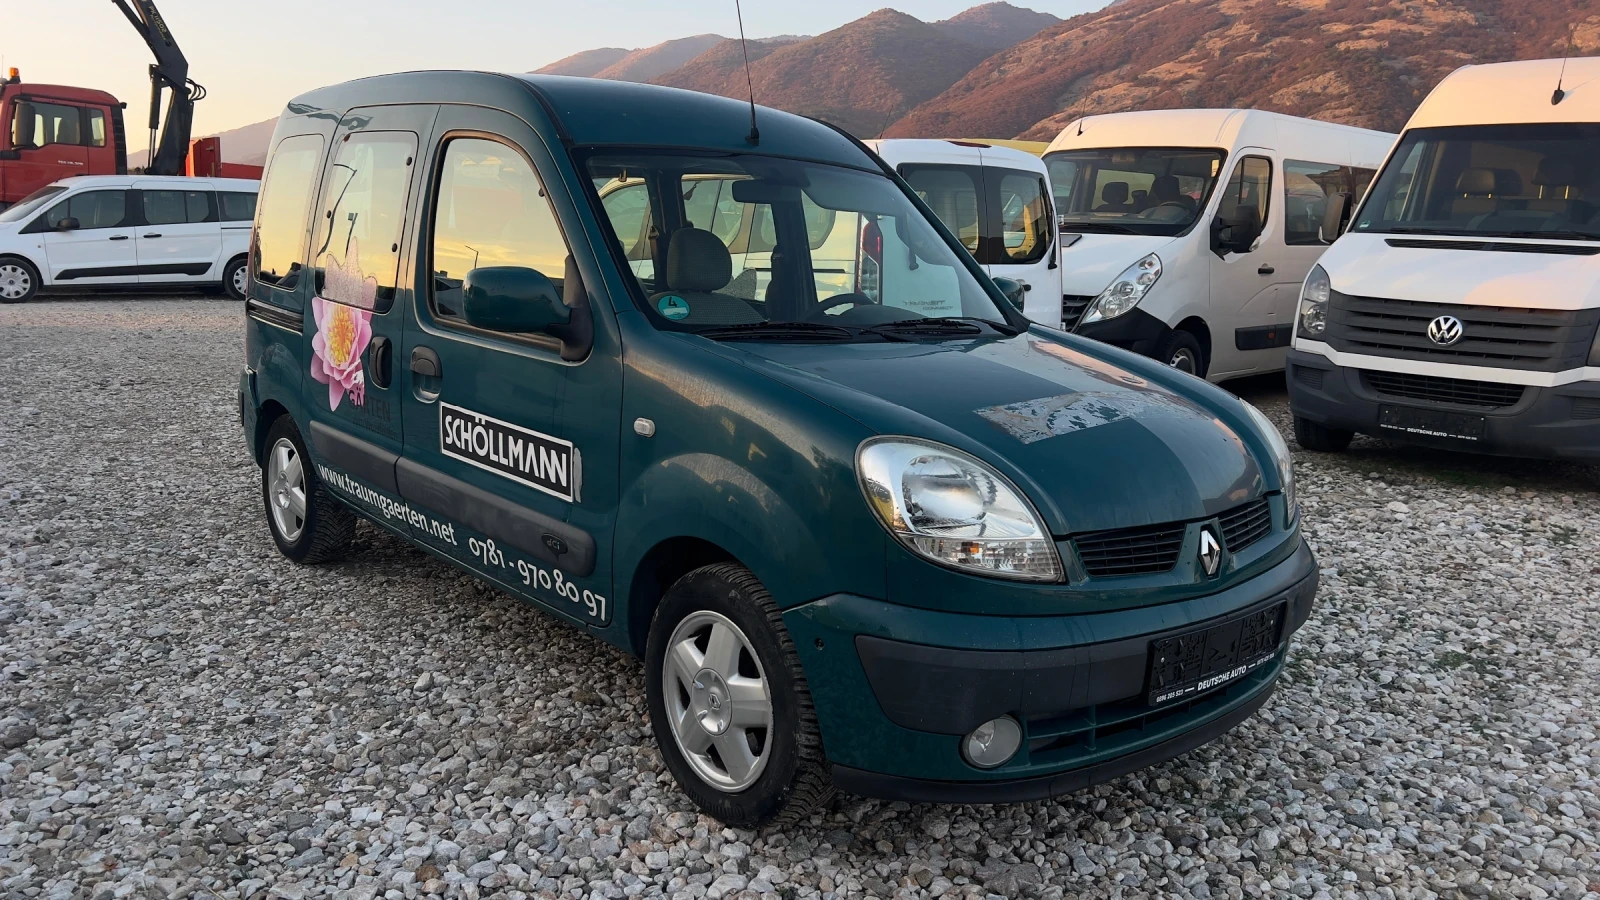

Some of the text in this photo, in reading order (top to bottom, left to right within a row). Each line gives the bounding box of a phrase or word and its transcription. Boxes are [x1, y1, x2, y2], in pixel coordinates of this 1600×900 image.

[668, 296, 678, 308] 4
[444, 415, 567, 488] SCHÖLLMANN
[317, 463, 458, 546] www.traumgaerten.net
[468, 537, 505, 569] 0781
[517, 559, 552, 590] 970
[553, 568, 580, 603] 80
[582, 589, 606, 621] 97
[1197, 673, 1231, 691] DEUTSCHE
[1230, 665, 1247, 679] AUTO
